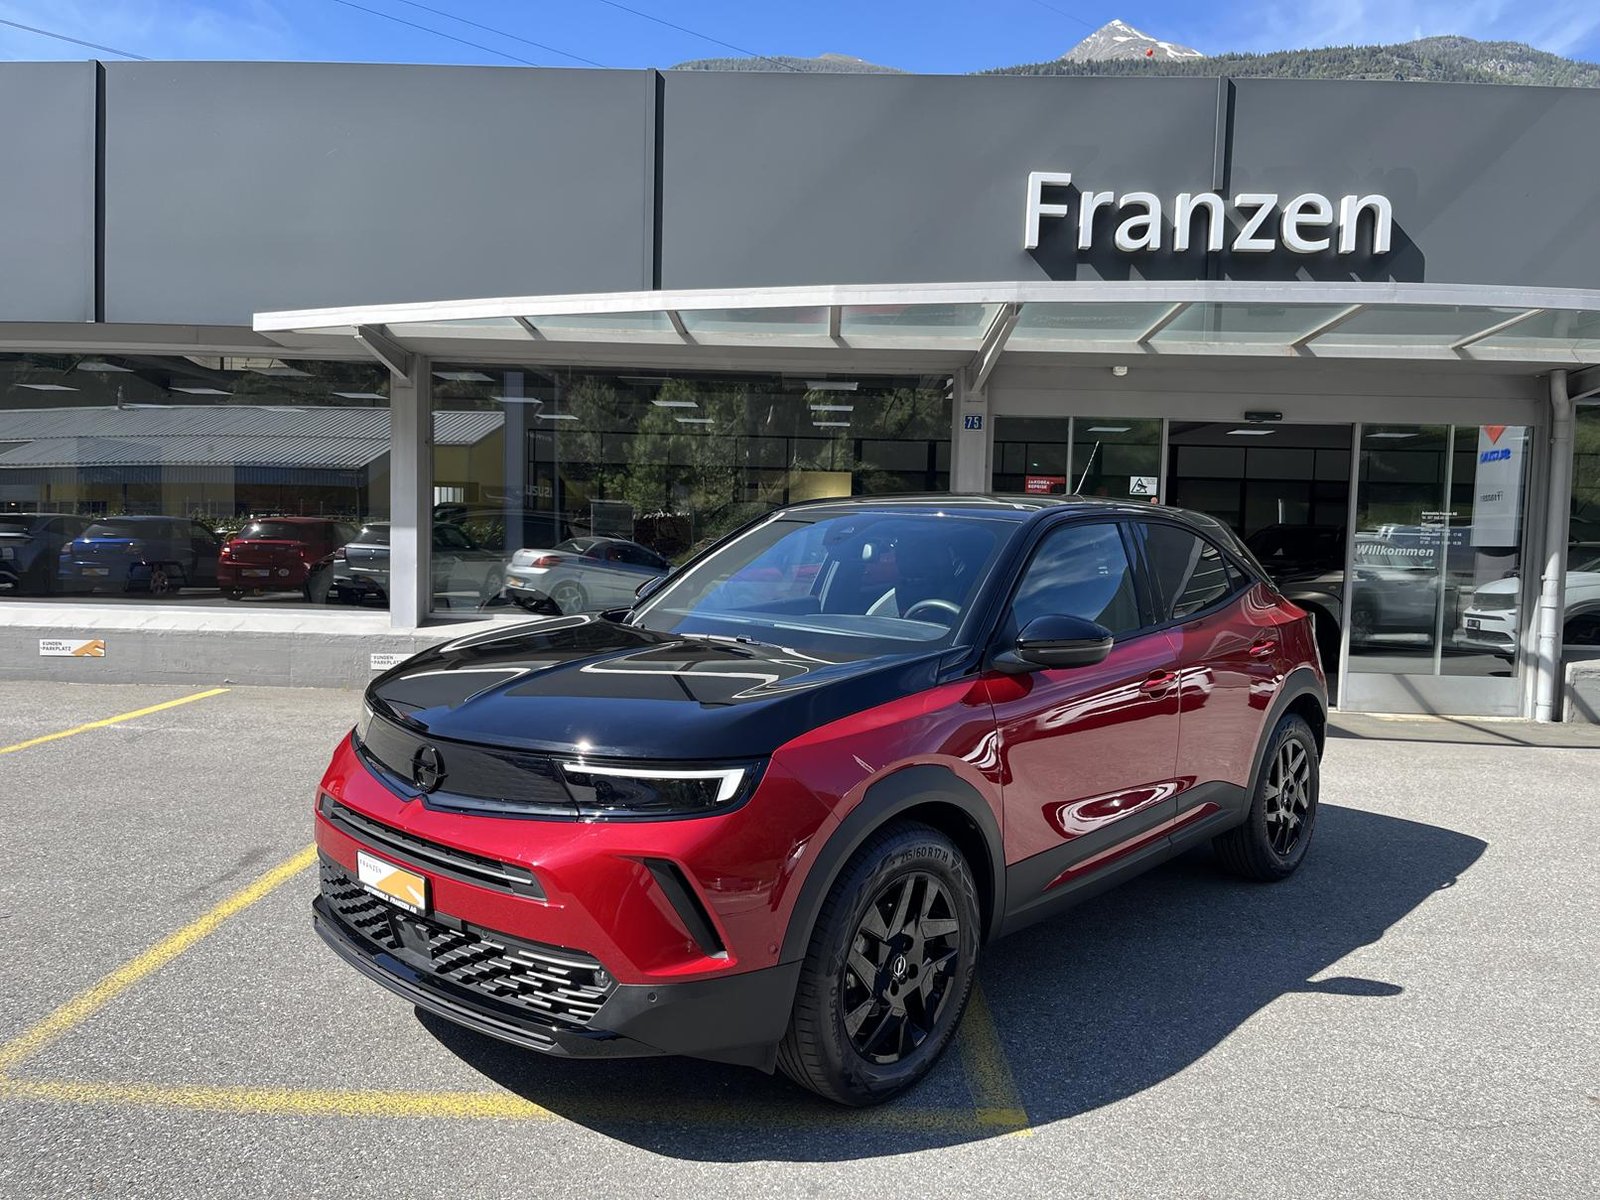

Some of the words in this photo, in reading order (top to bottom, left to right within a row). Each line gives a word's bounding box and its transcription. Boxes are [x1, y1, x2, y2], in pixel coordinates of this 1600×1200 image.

[1024, 171, 1393, 254] Franzen
[967, 416, 979, 429] 75
[1356, 544, 1434, 557] Willkommen
